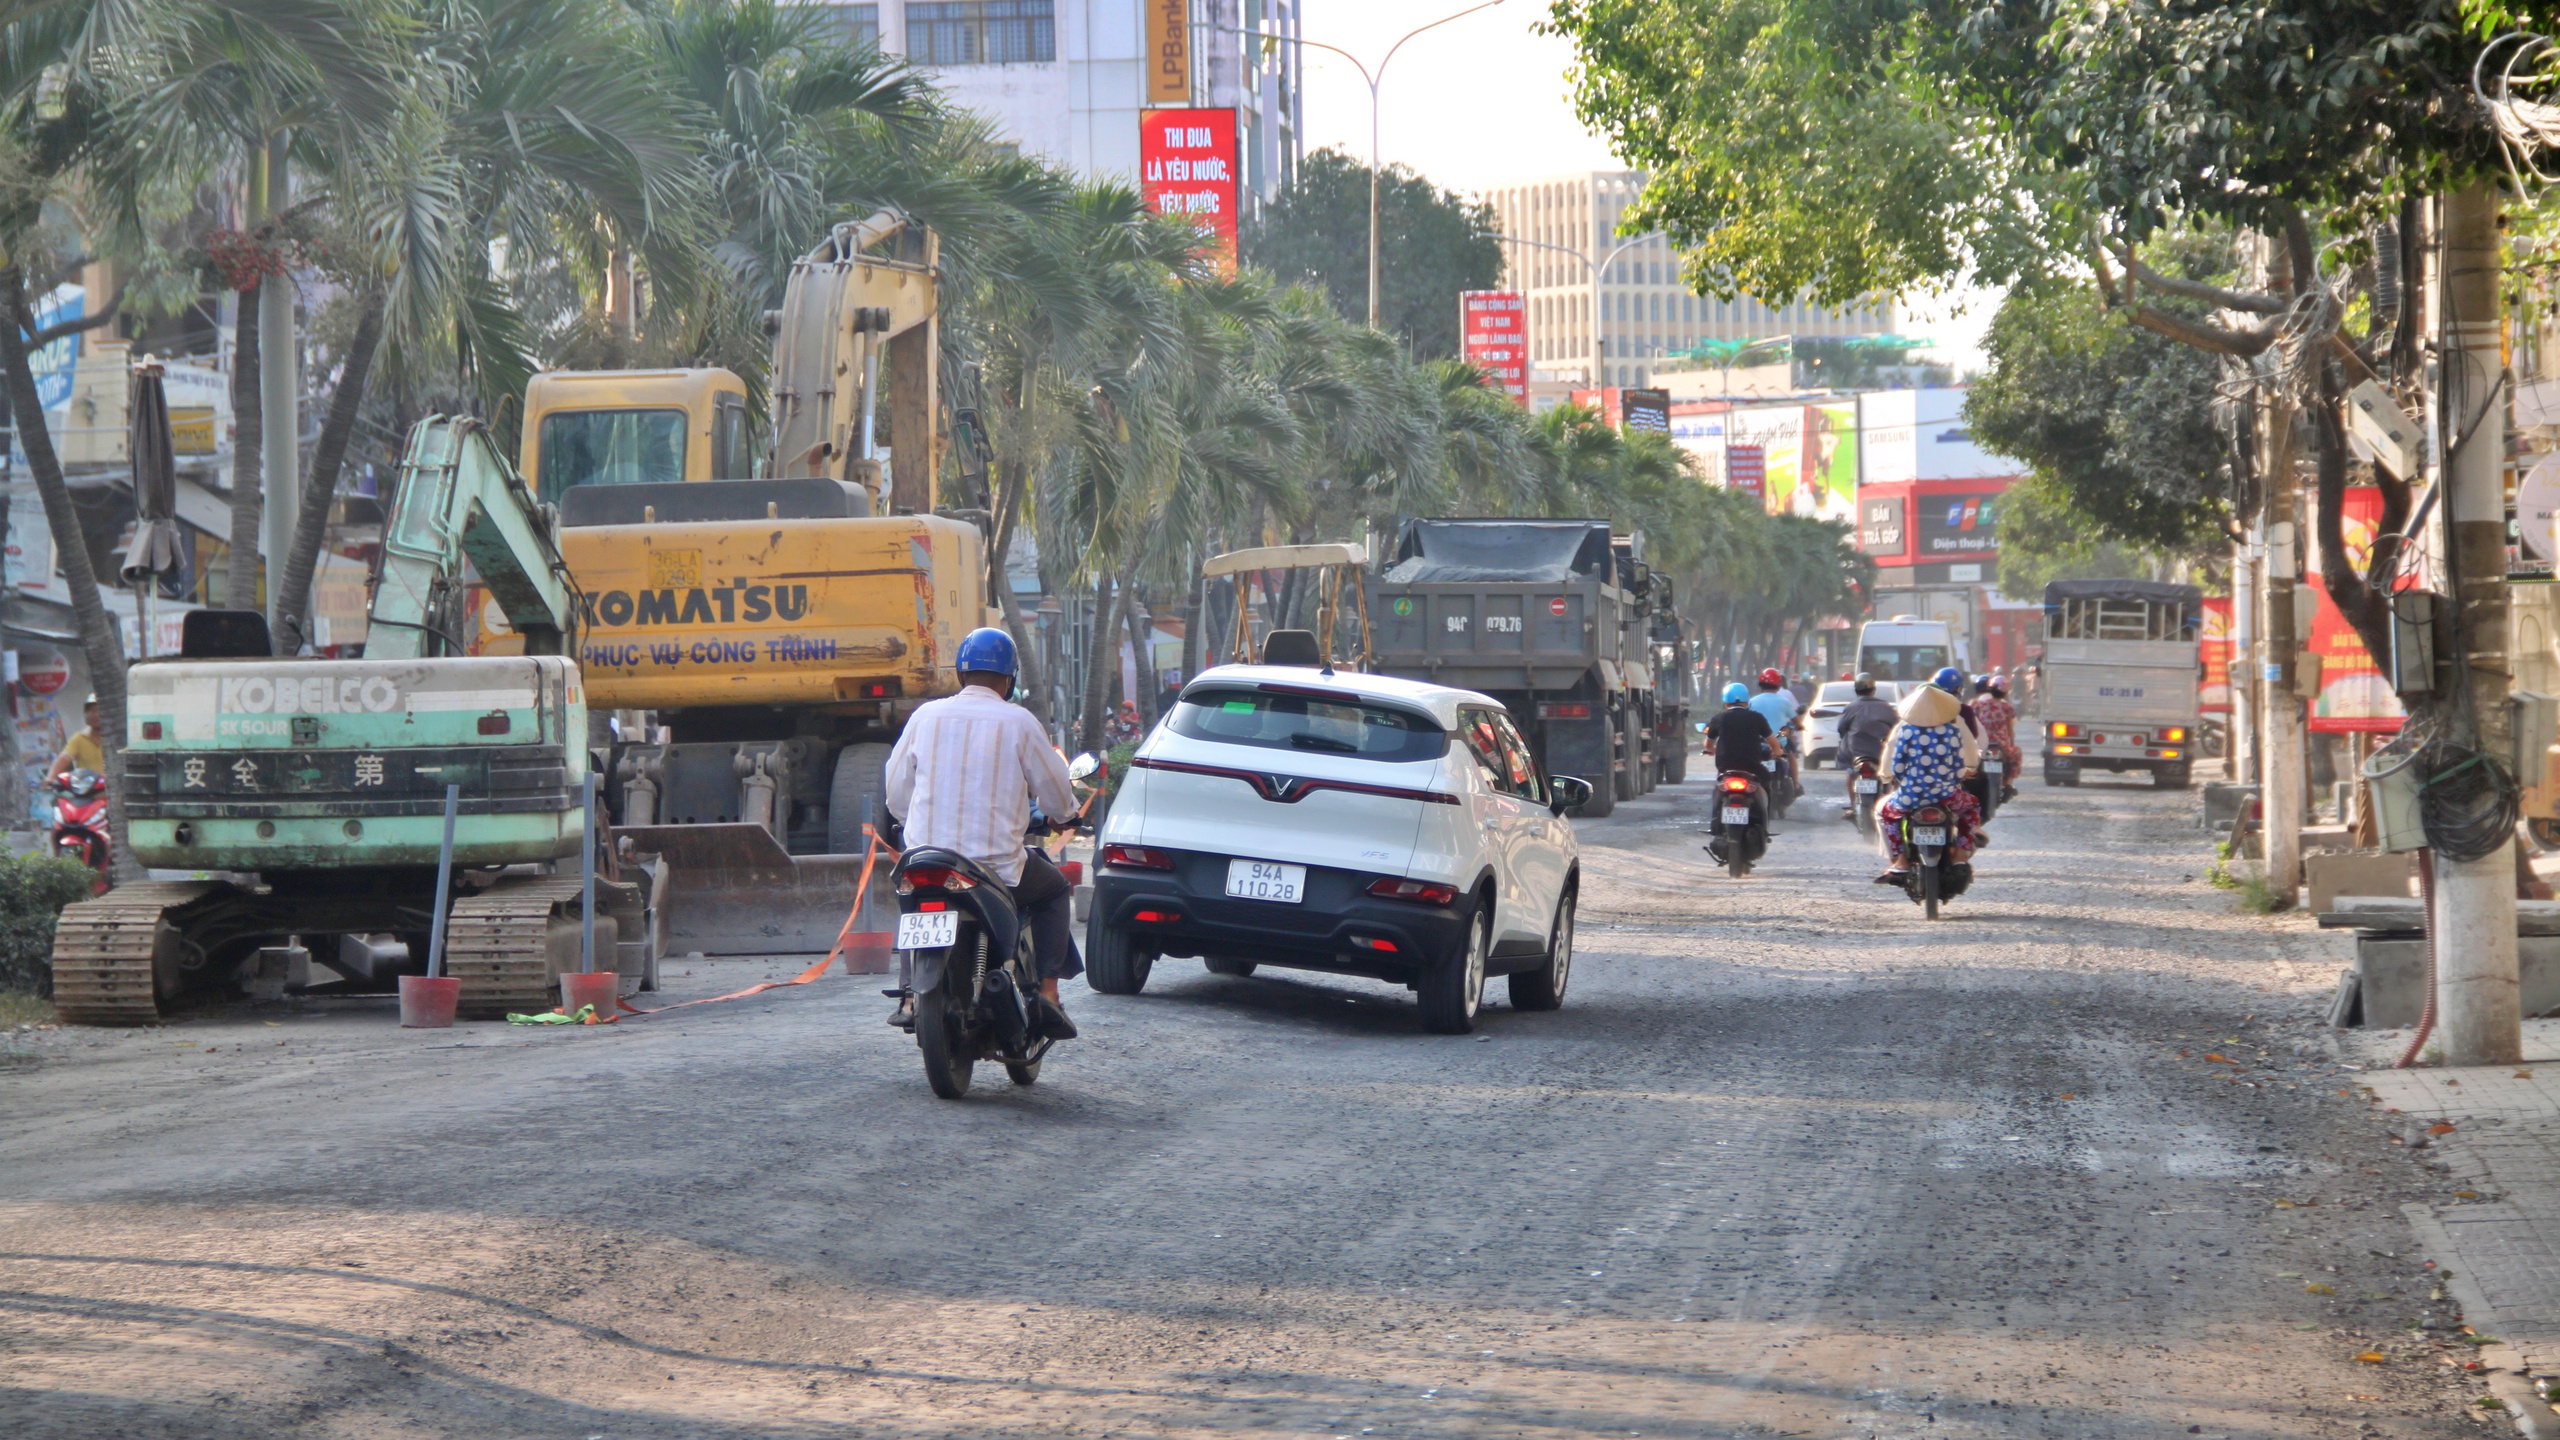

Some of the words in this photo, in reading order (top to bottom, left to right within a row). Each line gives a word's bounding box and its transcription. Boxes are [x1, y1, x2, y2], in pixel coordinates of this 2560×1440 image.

[1162, 0, 1184, 90] LPBank
[1164, 127, 1184, 148] THI
[1187, 127, 1212, 148] ĐUA
[1147, 156, 1163, 181] LÀ
[1166, 156, 1190, 182] YÊU
[1193, 156, 1230, 183] NƯỚC,
[1872, 503, 1890, 522] BÁN
[1934, 537, 1957, 551] Điện
[575, 577, 807, 627] KOMATSU
[584, 643, 639, 672] PHỤC
[692, 634, 757, 665] CÔNG
[764, 636, 837, 663] TRÌNH
[221, 677, 398, 714] KOBELCO
[1251, 863, 1283, 882] 94A
[1236, 879, 1295, 899] 110.28
[902, 930, 952, 946] 769.43
